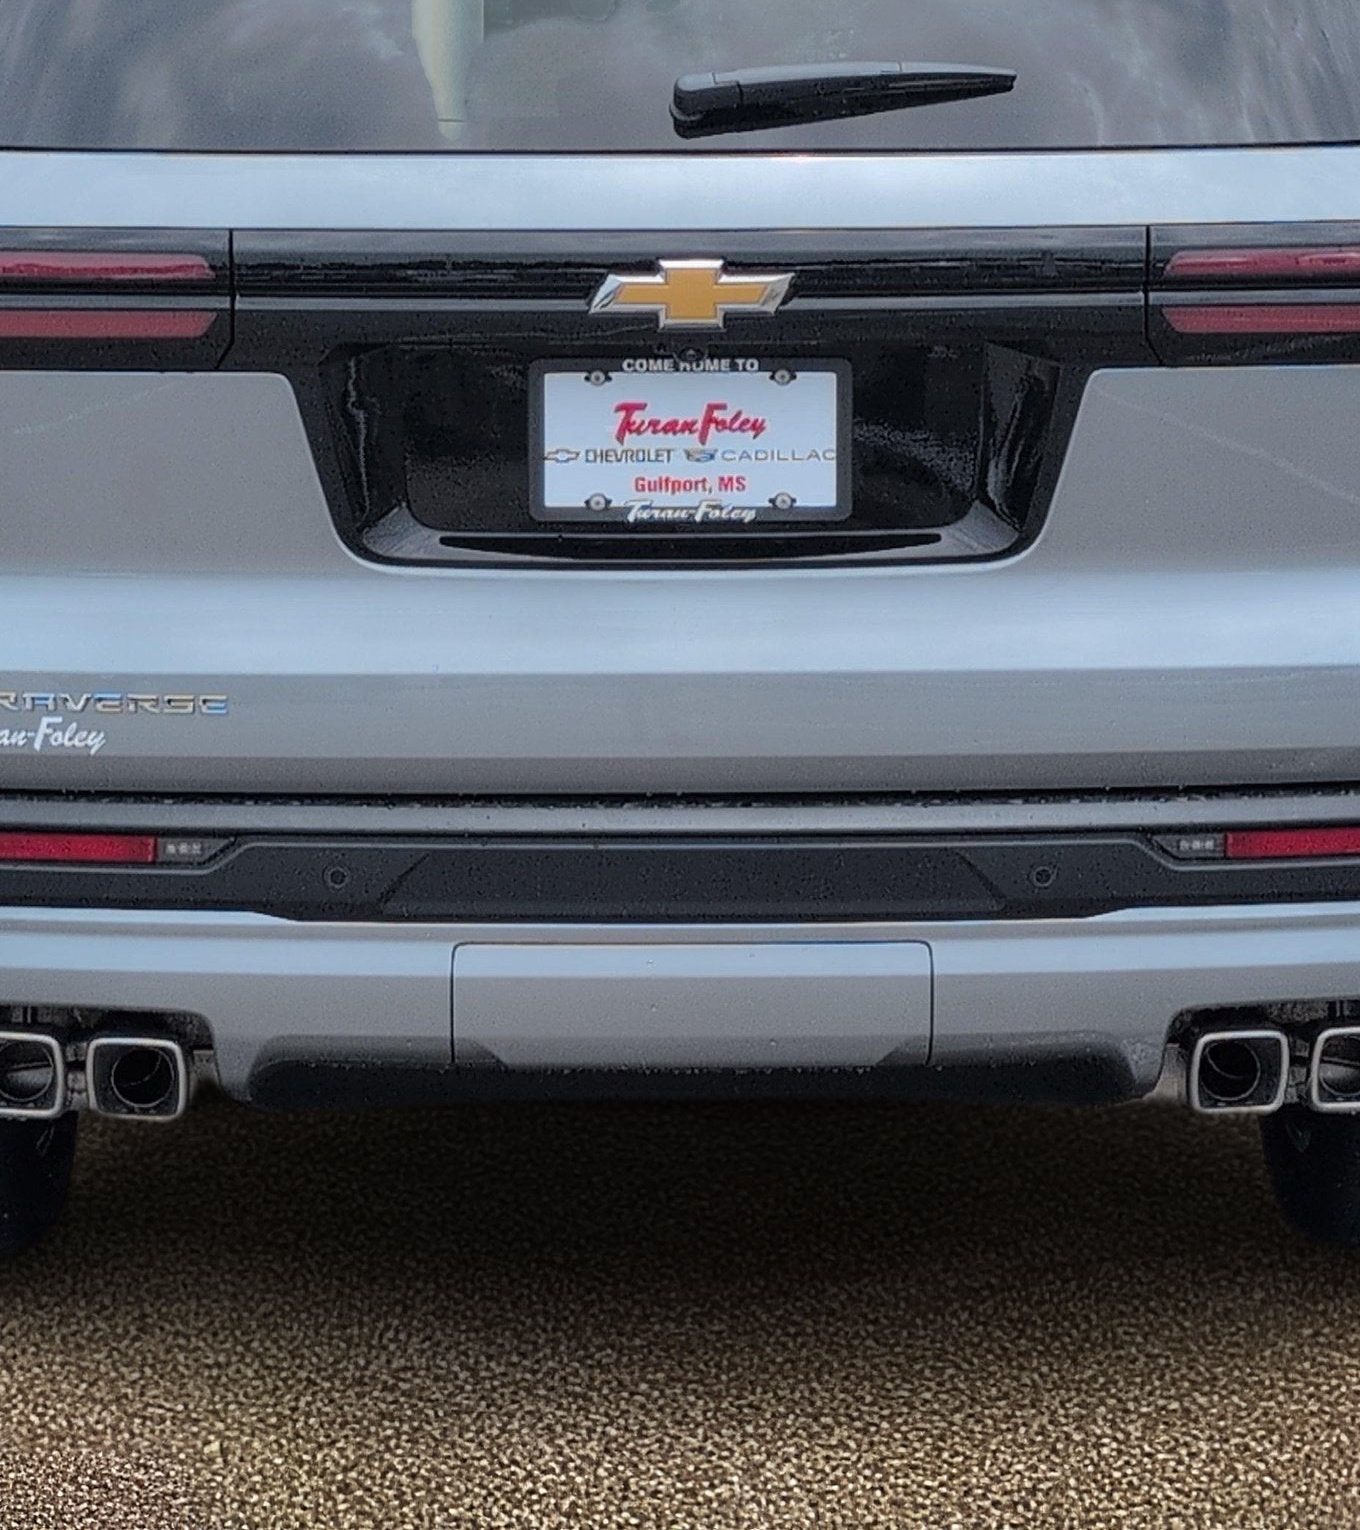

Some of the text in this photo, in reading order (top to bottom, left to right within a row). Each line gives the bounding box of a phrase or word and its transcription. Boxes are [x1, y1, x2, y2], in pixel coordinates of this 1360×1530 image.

[622, 357, 674, 372] COME
[735, 358, 760, 372] TO
[584, 448, 836, 464] CHEVROLET CADILLAC
[634, 475, 747, 495] Gulfport, MS
